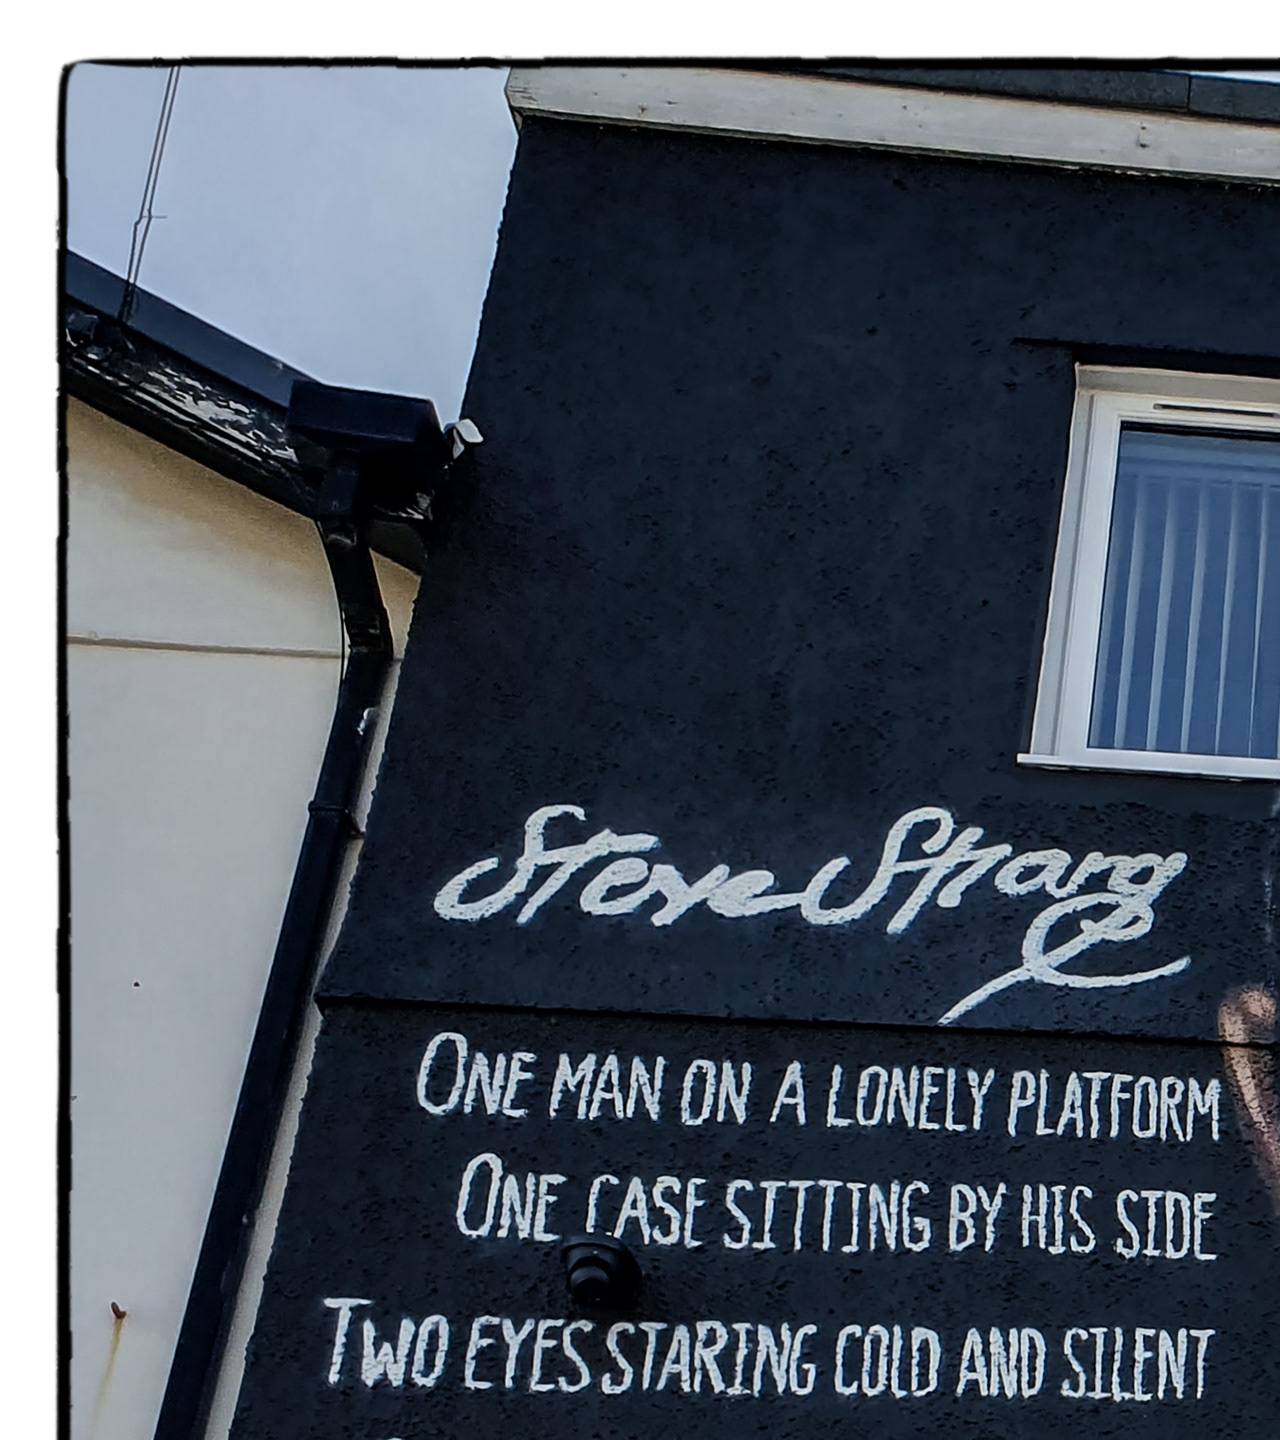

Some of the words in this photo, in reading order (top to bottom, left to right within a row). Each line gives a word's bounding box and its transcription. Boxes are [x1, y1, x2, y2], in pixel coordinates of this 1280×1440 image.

[434, 805, 801, 926] Steve
[417, 1032, 536, 1117] ONE
[550, 1054, 666, 1121] MAN
[681, 1060, 751, 1125] ON
[770, 1061, 805, 1125] A
[827, 1065, 994, 1131] LONELY
[1008, 1069, 1221, 1142] PLATFORM
[456, 1153, 567, 1241] ONE
[586, 1175, 706, 1248] CASE
[723, 1179, 931, 1253] SITTING
[949, 1183, 1005, 1252] BY
[1022, 1184, 1096, 1254] HIS
[1116, 1190, 1217, 1260] SIDE
[324, 1298, 449, 1387] TWO
[465, 1315, 593, 1392] EYES
[602, 1321, 817, 1397] STARING
[835, 1325, 941, 1398] COLD
[956, 1327, 1046, 1399] AND
[1061, 1327, 1215, 1402] SILENT
